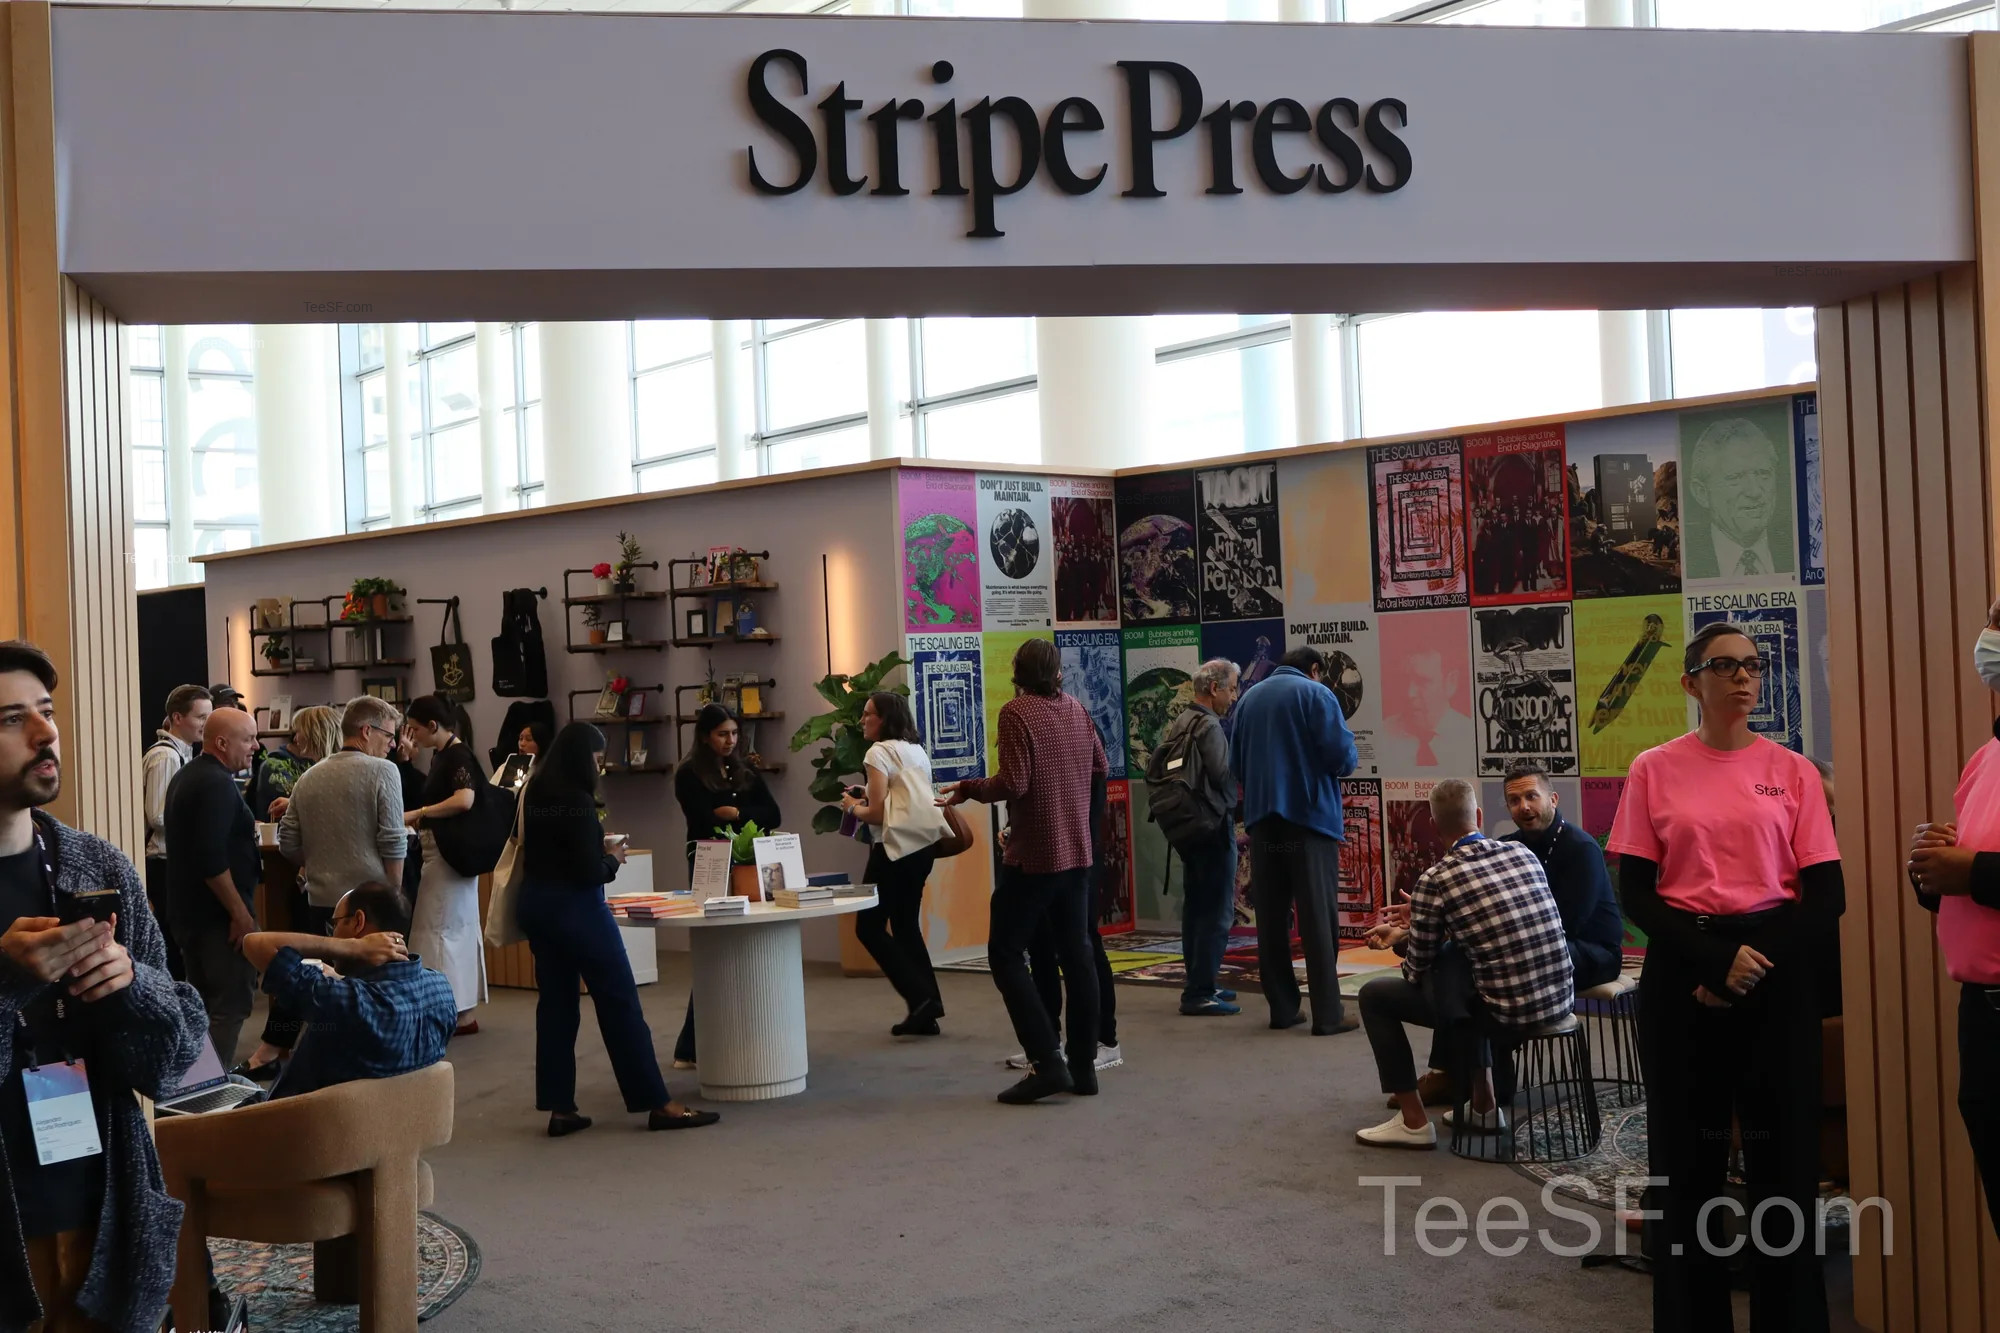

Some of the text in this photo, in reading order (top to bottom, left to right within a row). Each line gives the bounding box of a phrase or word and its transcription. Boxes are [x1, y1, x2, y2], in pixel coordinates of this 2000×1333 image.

[748, 48, 1412, 237] Stripe Press
[1797, 399, 1817, 415] TH
[1466, 430, 1556, 448] BOOM Bubbles and the
[1369, 439, 1460, 462] THE SCALING ERA
[1497, 439, 1562, 453] End of Stagnation
[1388, 469, 1448, 485] THE SCALING ERA
[980, 479, 1043, 492] DON'T JUST BUILD.
[994, 491, 1031, 503] MAINTAIN.
[1071, 488, 1112, 498] End of Stagnation
[1805, 568, 1816, 580] An
[1377, 600, 1386, 609] An
[1386, 599, 1398, 609] Oral
[1398, 597, 1418, 609] History
[1419, 598, 1425, 607] of
[1687, 591, 1797, 611] THE SCALING ERA
[1124, 628, 1194, 640] BOOM Bubbles and the
[1290, 620, 1369, 635] DON'T JUST BUILD.
[1764, 622, 1781, 633] ERA
[909, 636, 980, 650] THE SCALING ERA
[1056, 633, 1119, 647] THE SCALING ERA
[1148, 636, 1198, 646] End of Stagnation
[1306, 632, 1353, 645] MAINTAIN.
[925, 663, 971, 673] THE SCALING ERA
[1360, 782, 1379, 795] ERA
[1385, 782, 1409, 790] BOOM
[1585, 781, 1612, 790] BOOM
[1415, 790, 1429, 798] End
[1354, 809, 1367, 818] ERA
